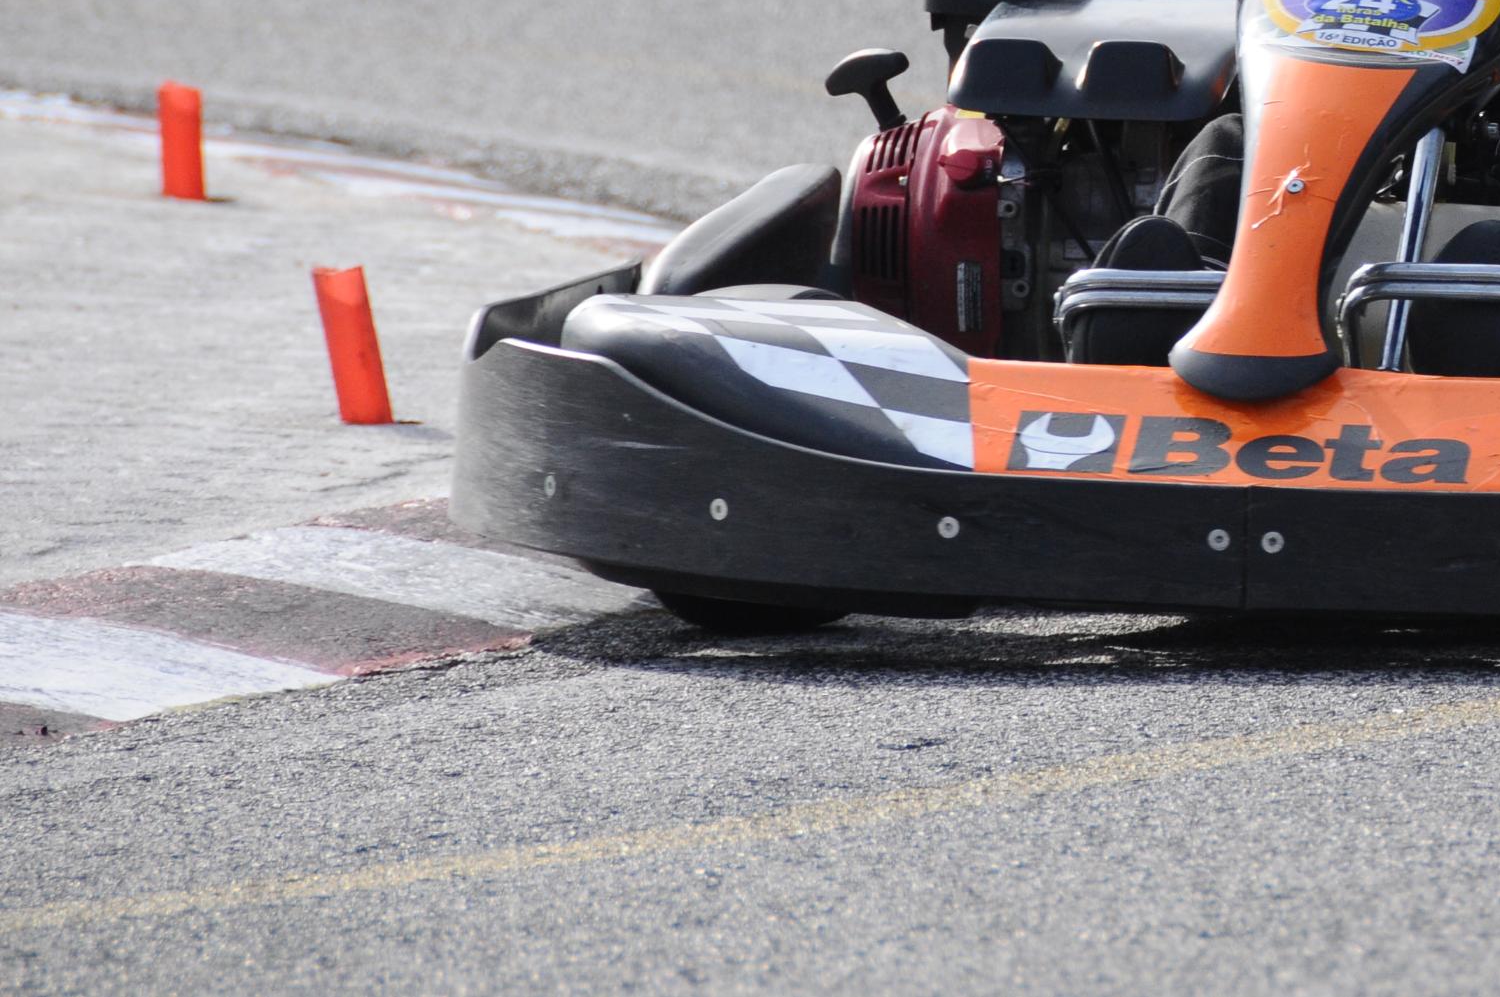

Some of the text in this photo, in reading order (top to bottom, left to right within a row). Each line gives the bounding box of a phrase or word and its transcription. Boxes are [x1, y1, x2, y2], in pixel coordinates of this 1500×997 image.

[1336, 6, 1384, 16] horas
[1313, 13, 1410, 32] da Batalha
[1342, 34, 1398, 48] EDIÇÃO
[1127, 415, 1470, 485] Beta
